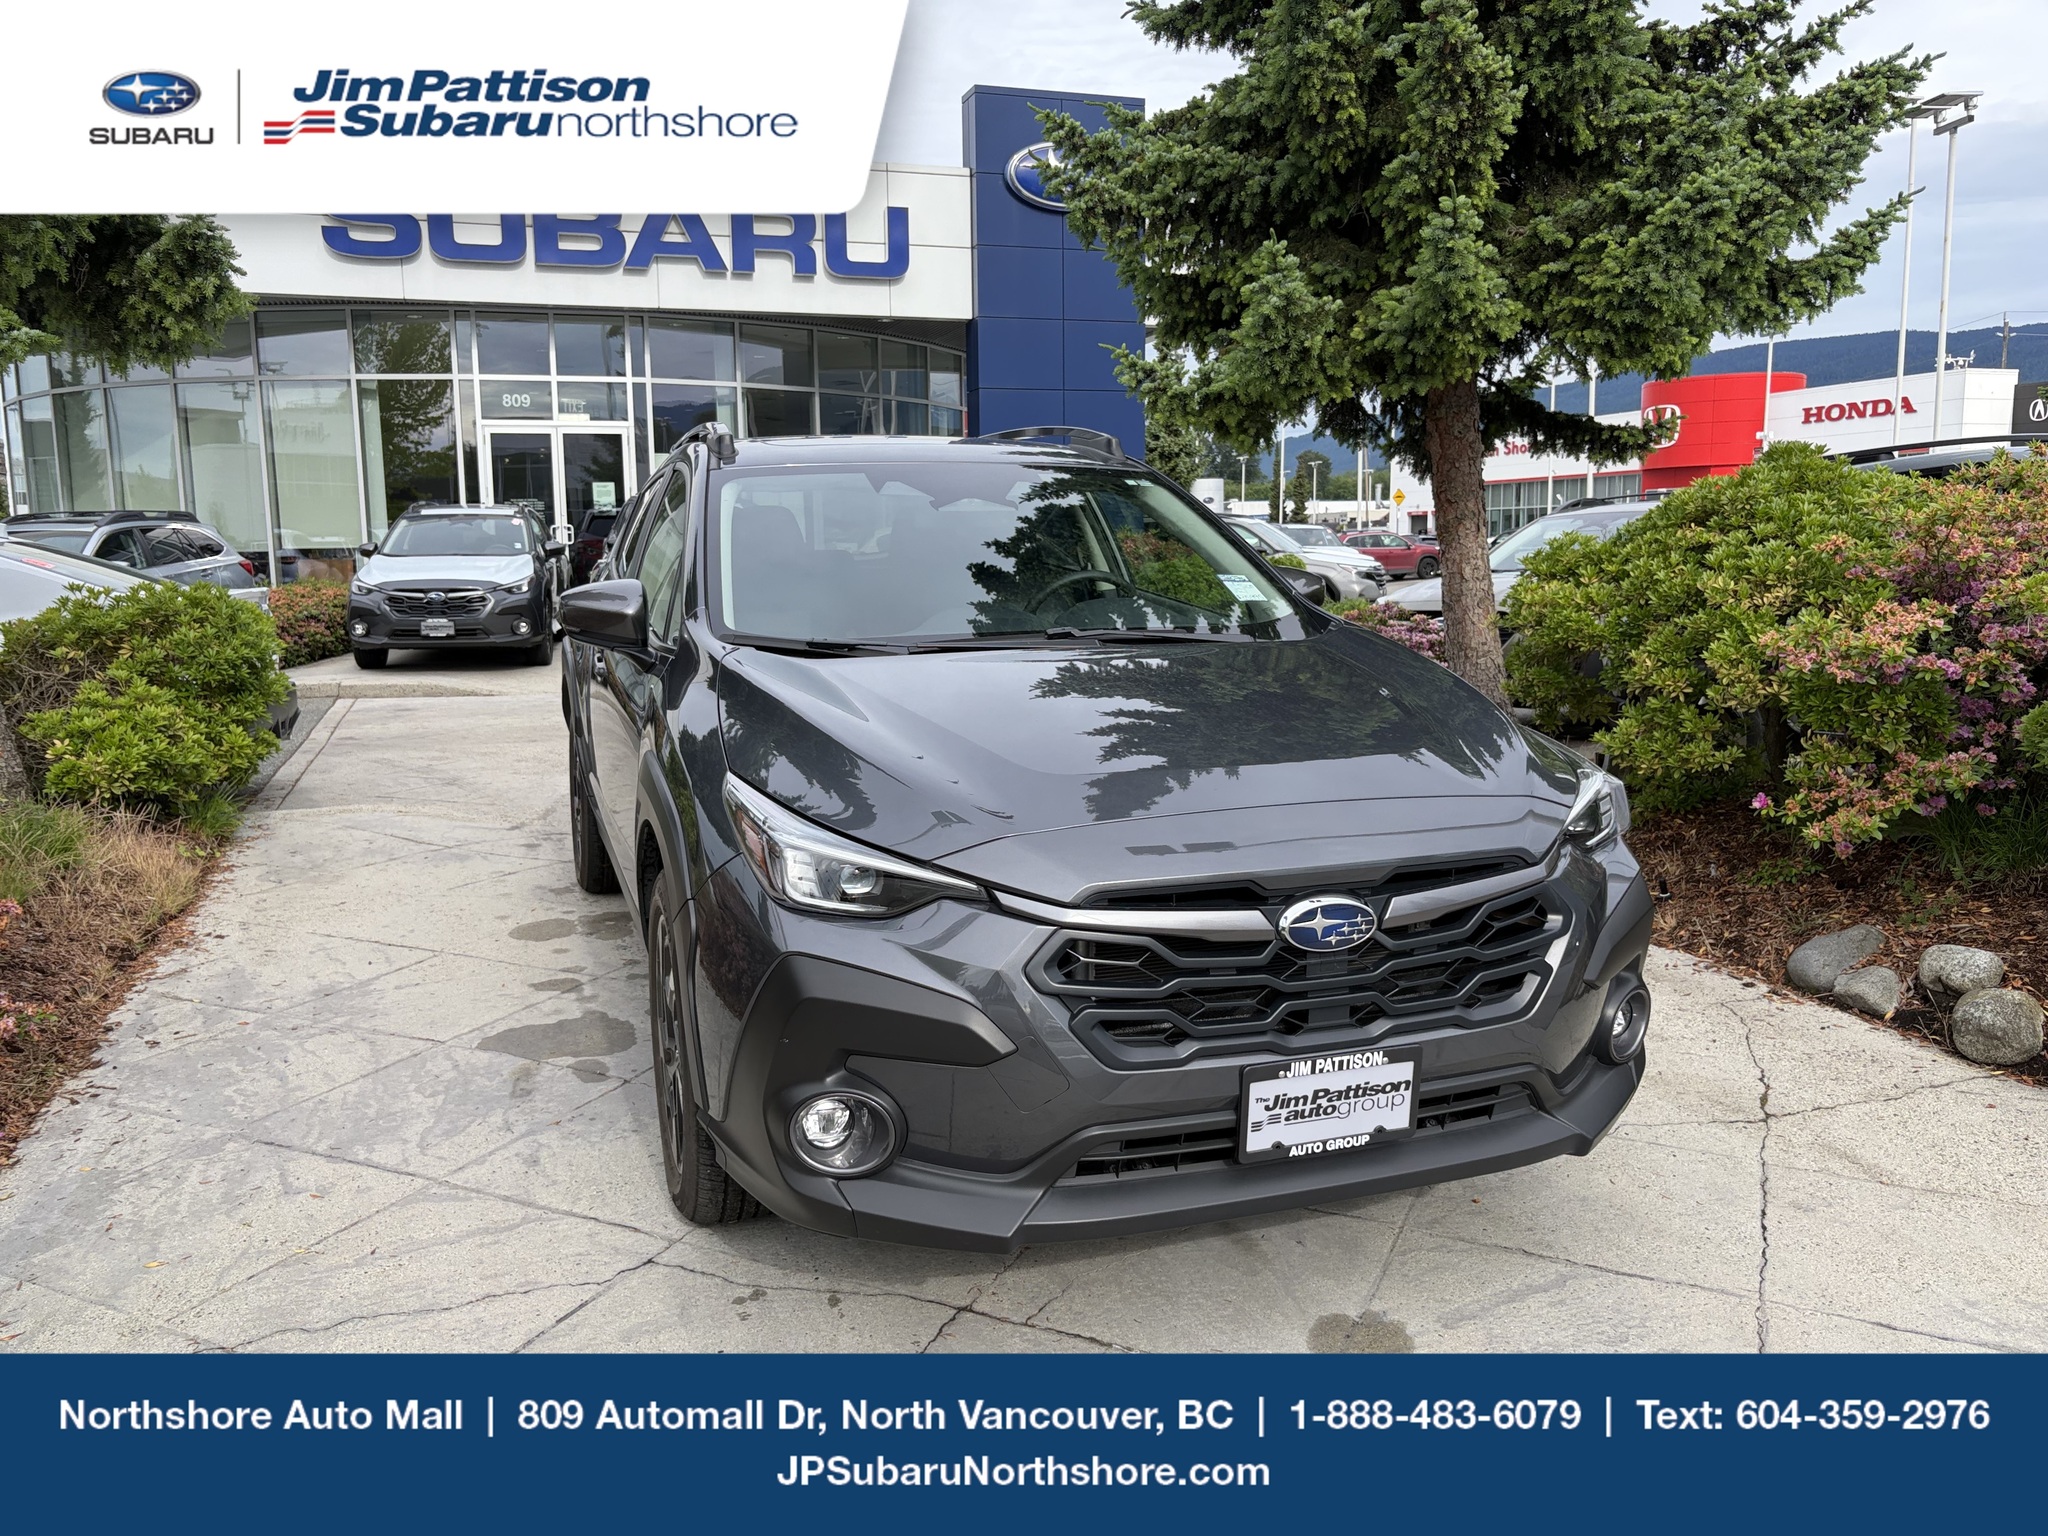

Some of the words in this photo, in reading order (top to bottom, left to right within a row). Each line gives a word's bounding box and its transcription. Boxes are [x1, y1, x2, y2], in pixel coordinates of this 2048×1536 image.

[321, 206, 910, 280] SUBARU
[502, 394, 531, 408] 809
[1801, 396, 1918, 425] HONDA
[1286, 1060, 1312, 1078] JIM
[1315, 1051, 1384, 1074] PATTISON
[1264, 1093, 1309, 1112] Jim
[1310, 1079, 1412, 1105] Pattison
[1289, 1143, 1323, 1157] AUTO
[1325, 1134, 1370, 1151] GROUP
